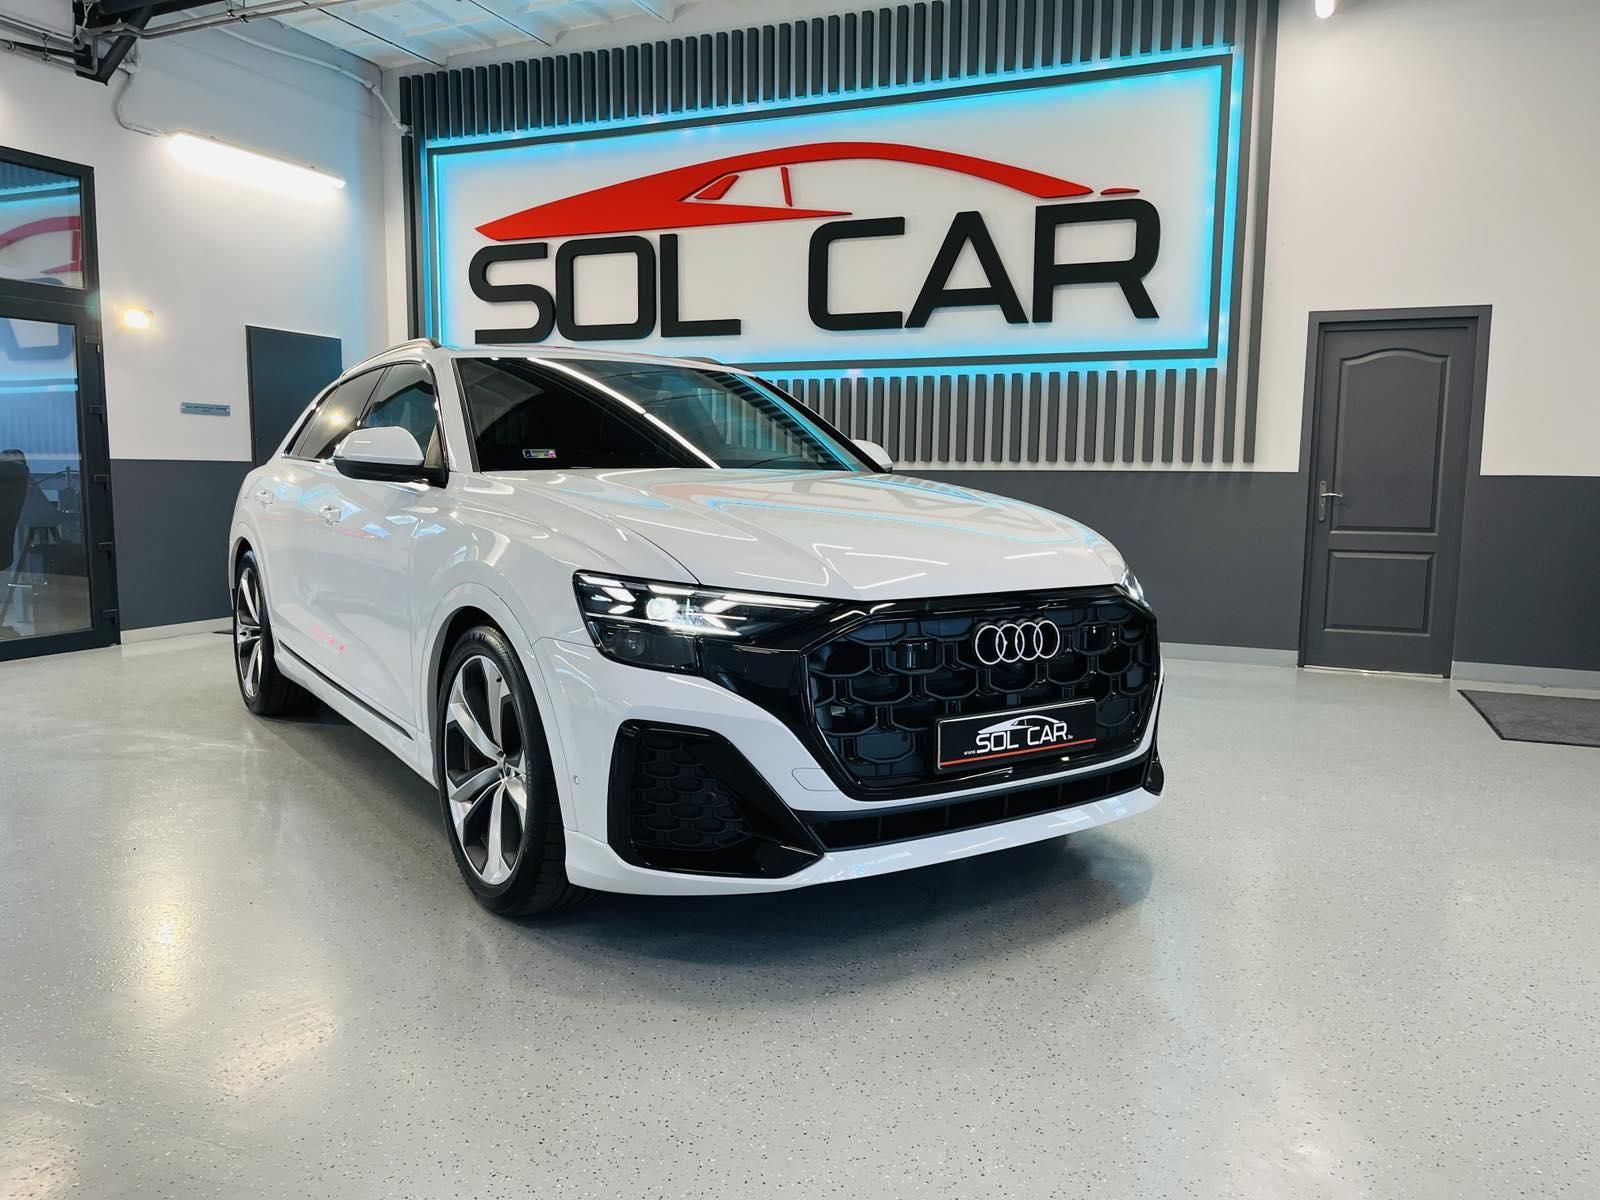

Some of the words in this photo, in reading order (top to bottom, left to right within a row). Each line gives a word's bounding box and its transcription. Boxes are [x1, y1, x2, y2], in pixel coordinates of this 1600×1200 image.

[469, 234, 741, 344] SOL
[808, 198, 1161, 331] CAR
[976, 731, 1019, 753] SOL
[1027, 722, 1067, 746] CAR
